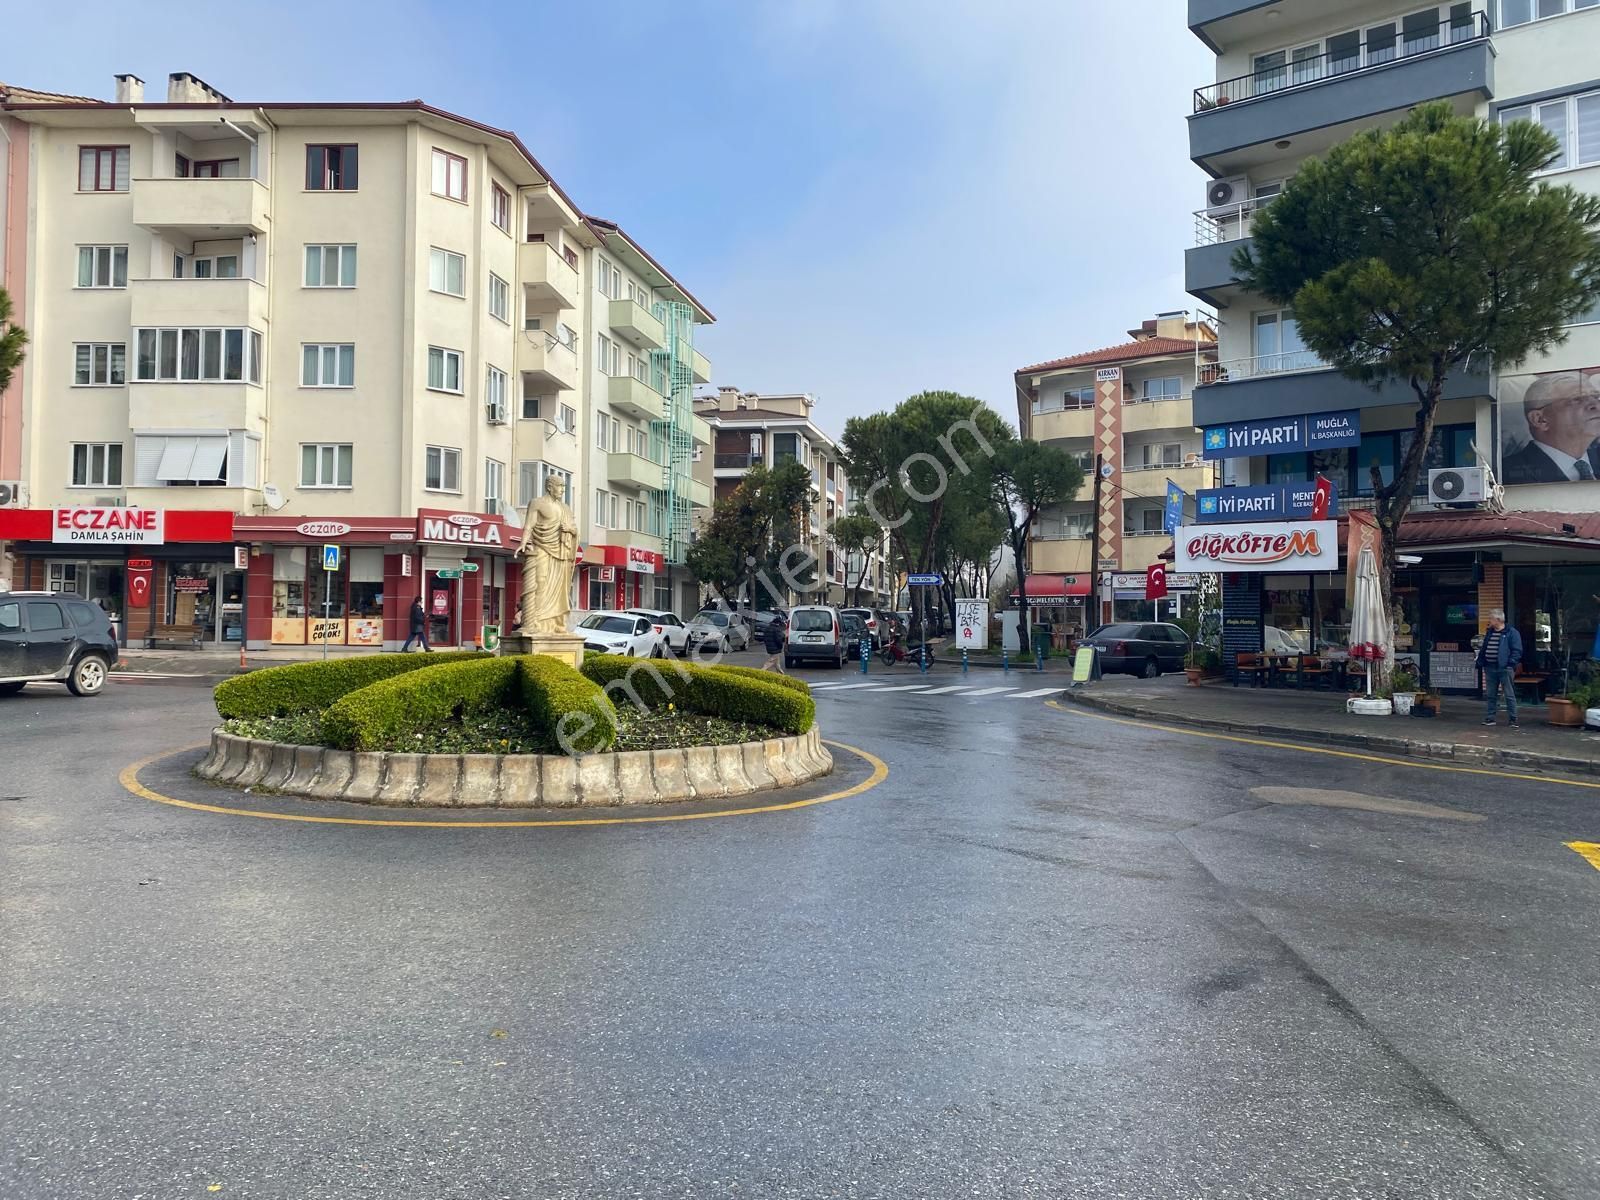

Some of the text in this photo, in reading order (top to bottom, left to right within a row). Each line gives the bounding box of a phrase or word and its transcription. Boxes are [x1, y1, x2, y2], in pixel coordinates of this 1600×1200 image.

[1316, 417, 1349, 430] MUĞLA
[1229, 420, 1298, 448] İYİ PARTİ
[1311, 432, 1318, 440] İL
[1219, 493, 1275, 513] İYİ PARTİ
[57, 509, 157, 530] ECZANE
[452, 515, 479, 524] eczane
[302, 524, 344, 534] eczane
[424, 519, 501, 544] MUĞLA
[71, 531, 144, 542] DAMLA ŞAHİN
